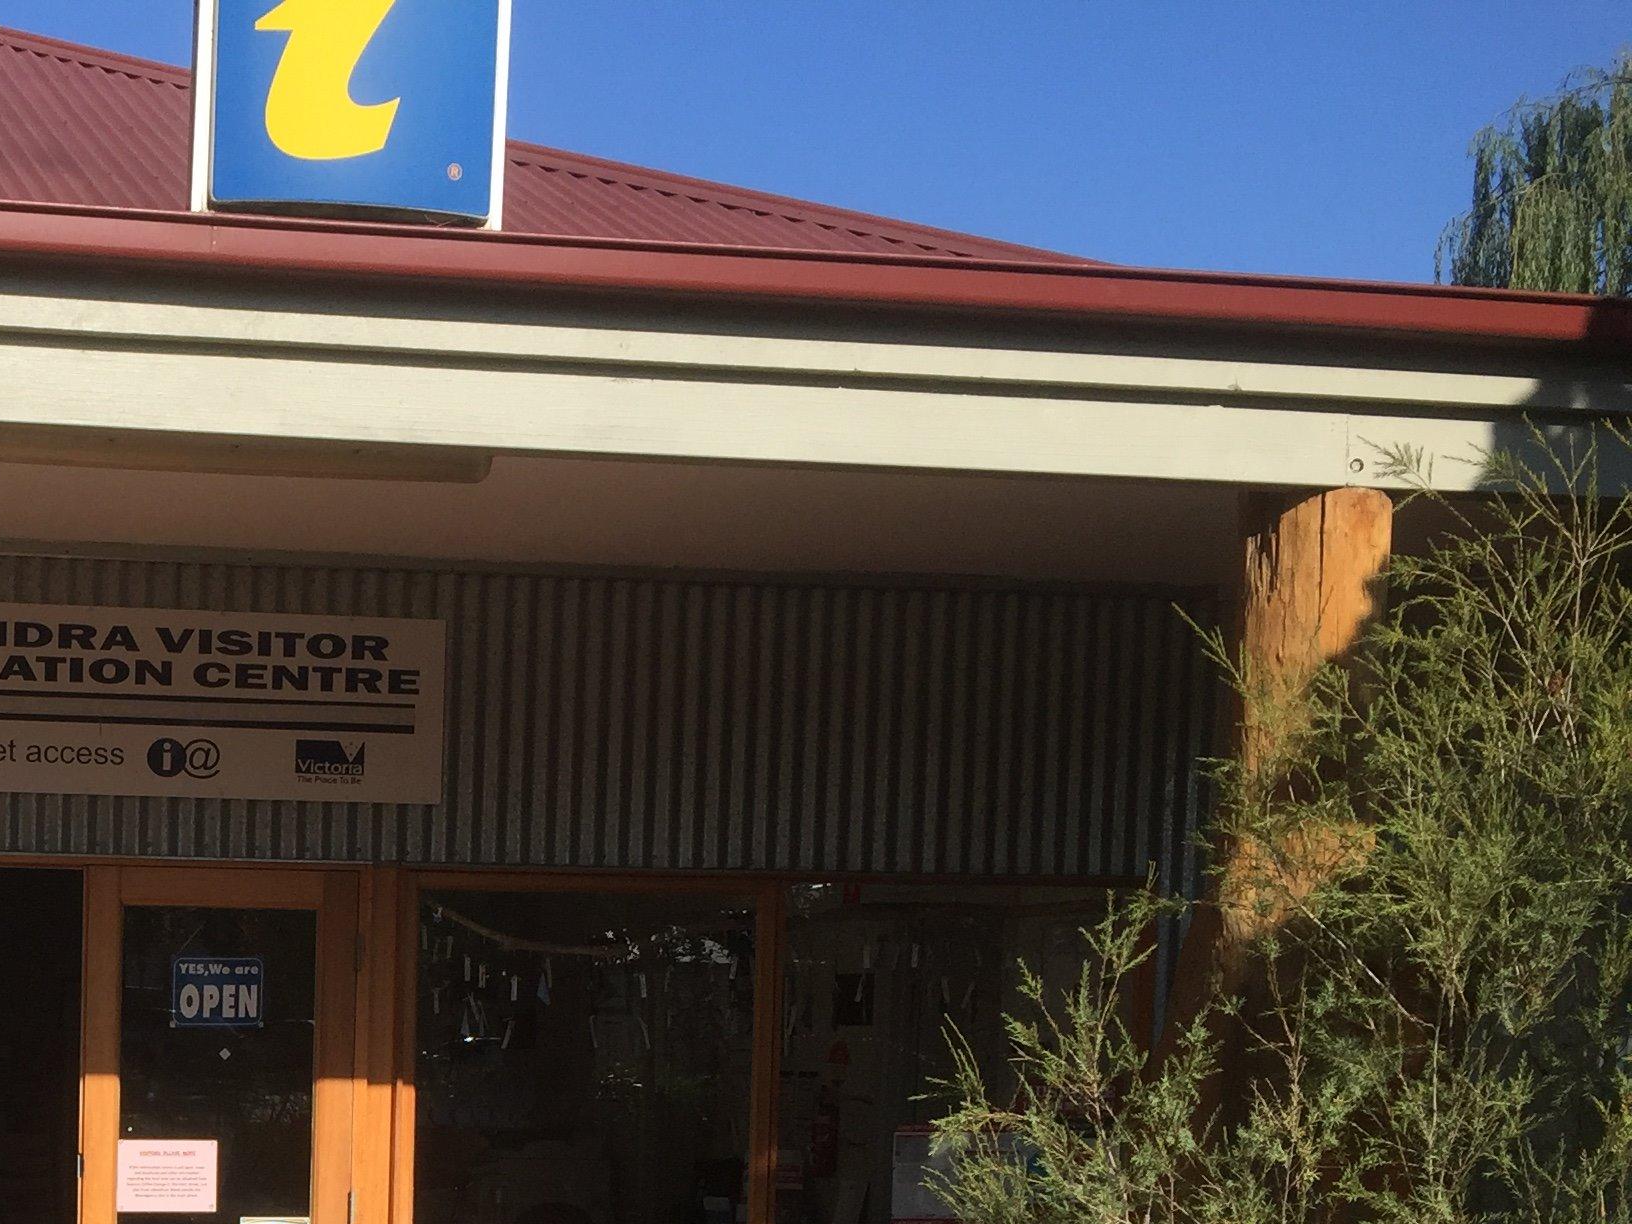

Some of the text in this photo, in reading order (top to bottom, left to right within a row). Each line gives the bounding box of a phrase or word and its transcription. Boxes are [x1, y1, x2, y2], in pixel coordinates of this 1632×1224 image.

[154, 627, 390, 662] VISITOR
[192, 661, 421, 696] CENTRE
[25, 743, 125, 766] access
[296, 758, 365, 775] Victoria
[235, 965, 259, 975] are
[179, 983, 258, 1018] OPEN
